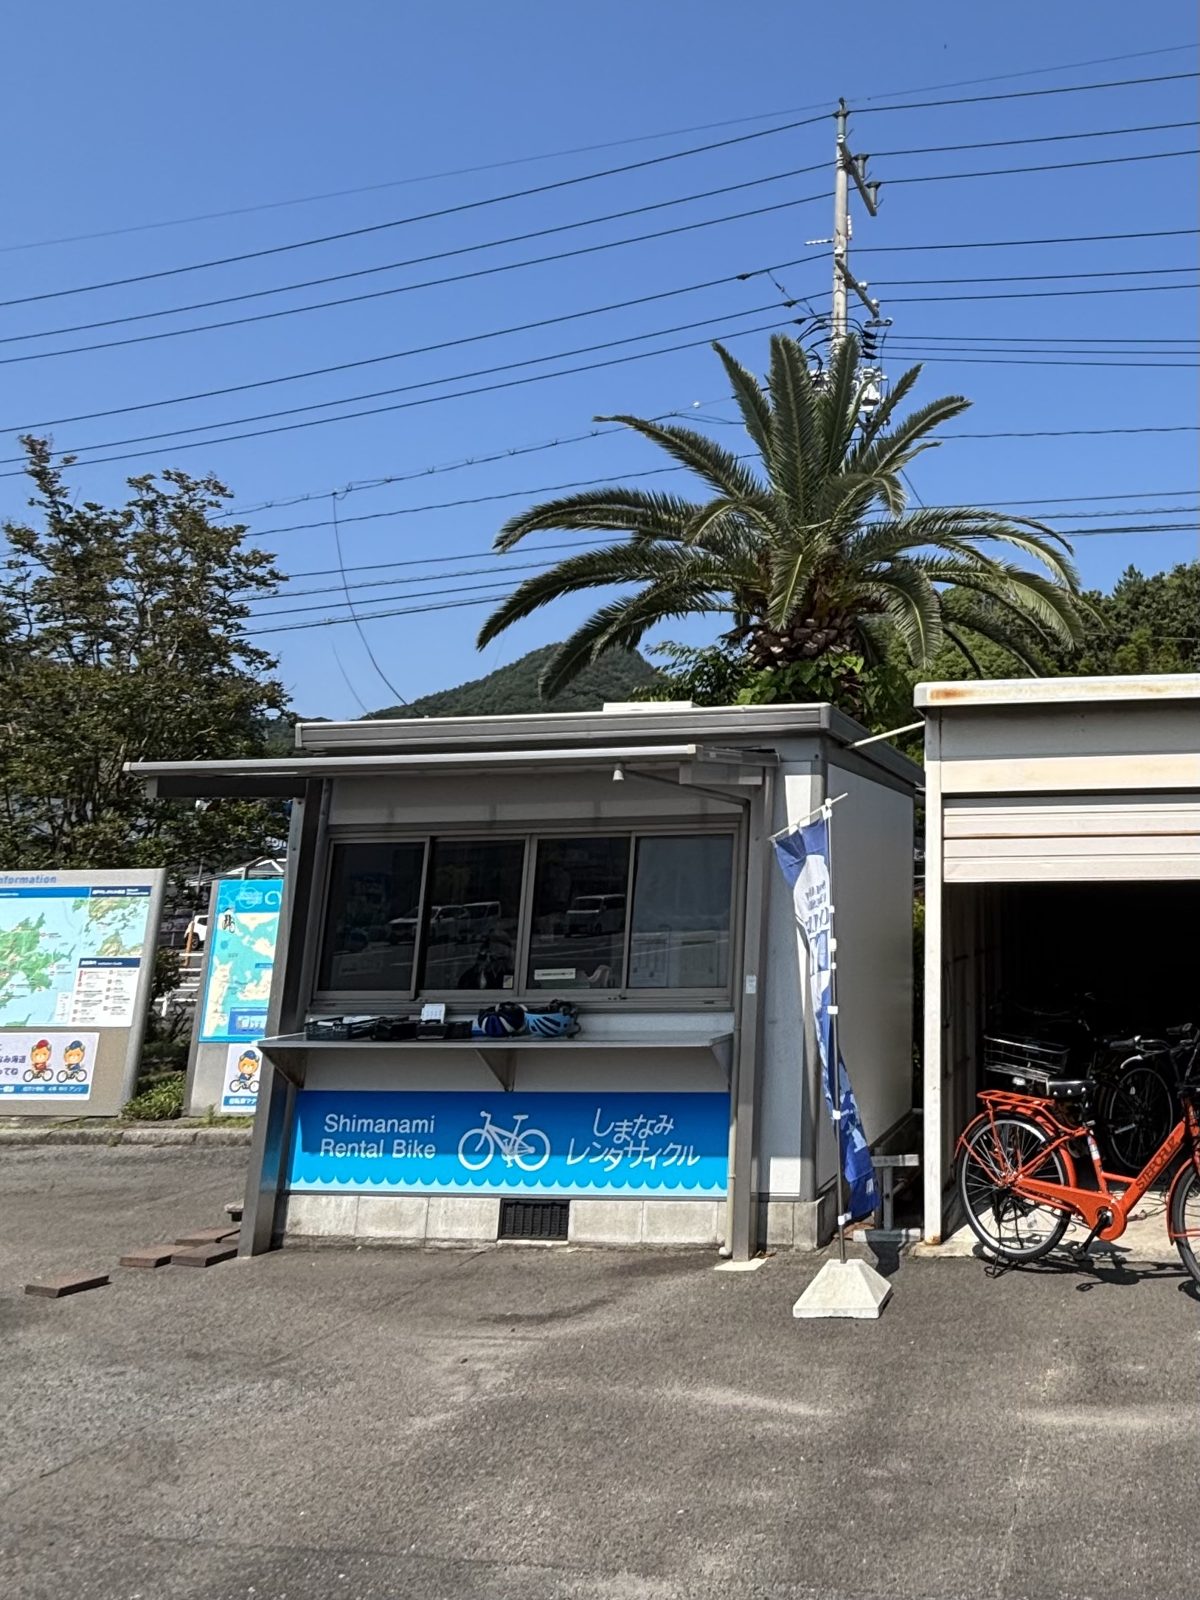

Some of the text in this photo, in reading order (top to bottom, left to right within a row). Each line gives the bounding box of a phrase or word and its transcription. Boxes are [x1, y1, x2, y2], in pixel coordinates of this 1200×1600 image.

[323, 1113, 436, 1134] Shimanami
[593, 1107, 675, 1144] しまなみ
[319, 1138, 436, 1159] Rental Bike
[566, 1137, 701, 1172] レンタサイクル
